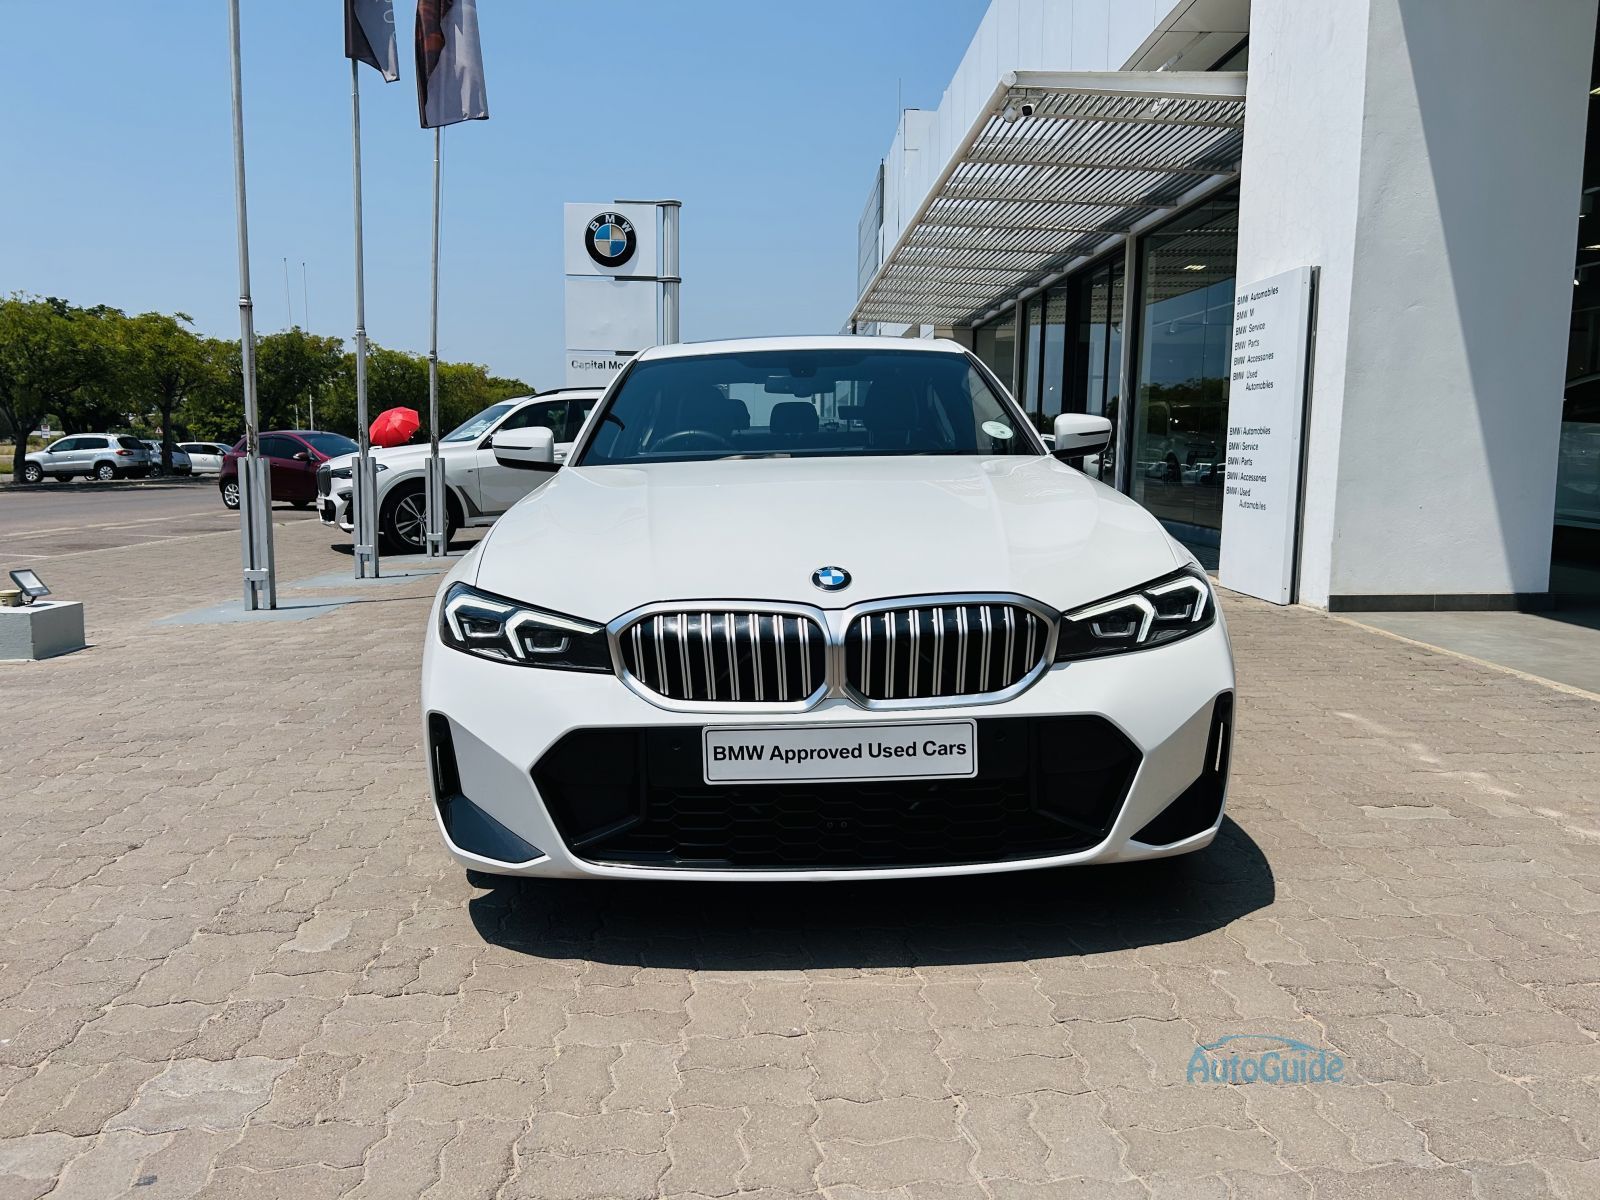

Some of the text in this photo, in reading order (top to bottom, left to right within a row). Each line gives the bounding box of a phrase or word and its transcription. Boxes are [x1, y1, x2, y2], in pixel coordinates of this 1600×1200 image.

[589, 214, 633, 233] BMW
[1238, 286, 1278, 304] BMW Automobiles
[1236, 312, 1248, 320] BMW
[1236, 322, 1266, 336] BMW Service
[1234, 340, 1260, 350] BMW Parts
[1234, 352, 1274, 366] BMW Accessories
[571, 360, 606, 371] Capital
[1232, 370, 1258, 380] BMW Used
[1246, 380, 1274, 390] Automobiles
[1244, 426, 1270, 436] Automobiles
[1242, 442, 1258, 450] Service
[1242, 458, 1252, 466] Parts
[1240, 472, 1266, 482] Accessories
[1240, 488, 1250, 496] Used
[1240, 500, 1266, 510] Automobiles
[712, 740, 967, 764] BMW Approved Used Cars
